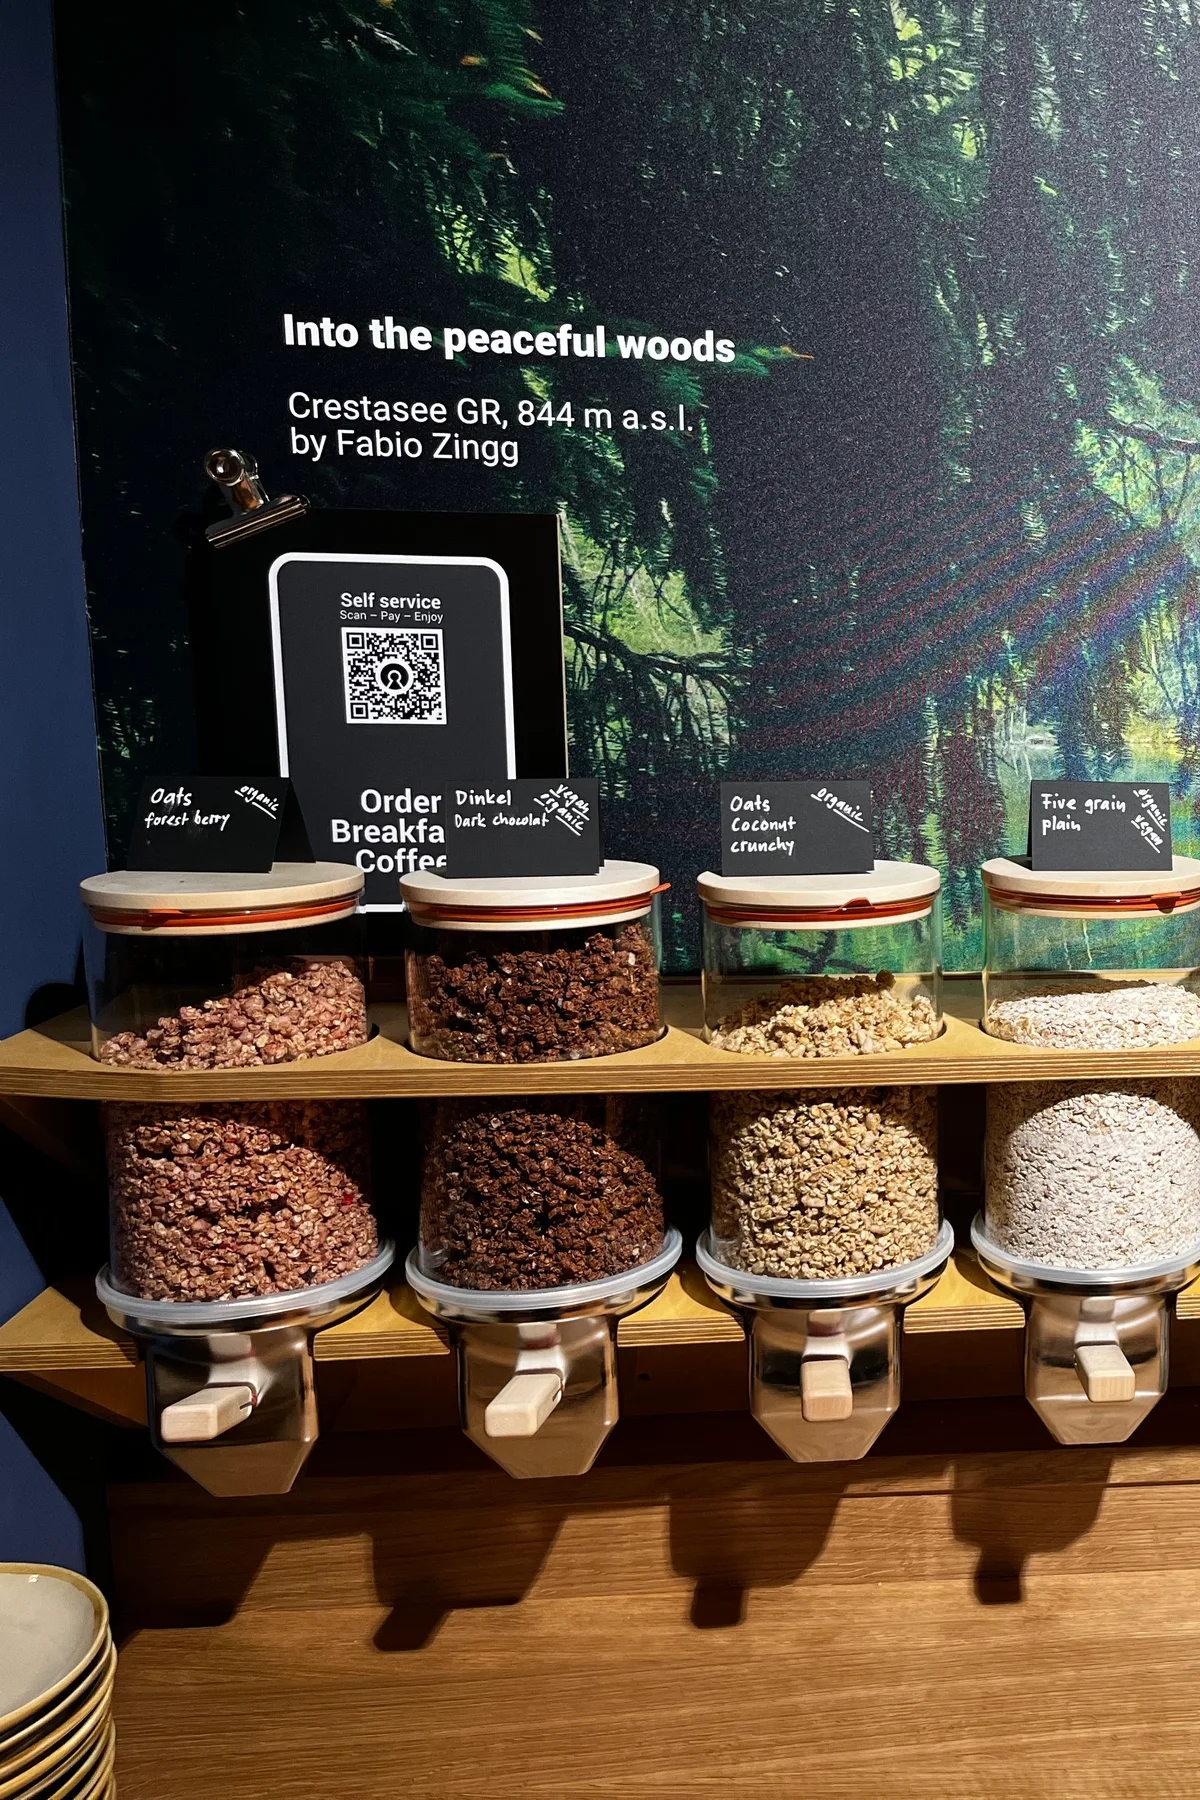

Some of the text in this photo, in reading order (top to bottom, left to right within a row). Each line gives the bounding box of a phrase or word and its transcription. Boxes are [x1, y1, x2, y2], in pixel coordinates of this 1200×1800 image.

[283, 313, 737, 364] Into the peaceful woods
[288, 391, 694, 432] Crestasee GR, 844 m a.s.l.
[290, 426, 519, 468] by Fabio Zingg
[340, 591, 442, 610] Self service
[339, 609, 367, 620] Scan
[380, 610, 401, 624] Pay
[414, 611, 444, 625] Enjoy
[150, 786, 193, 807] Oats
[360, 787, 442, 814] Order
[455, 788, 512, 806] Dinkel
[729, 794, 771, 812] Oats
[1040, 792, 1127, 815] Five grain
[144, 809, 231, 832] forest berry
[331, 817, 446, 844] Breakfa
[454, 811, 551, 829] Dark chocolat
[730, 815, 797, 832] Coconut
[1041, 813, 1081, 836] plain
[729, 836, 796, 857] crunchy
